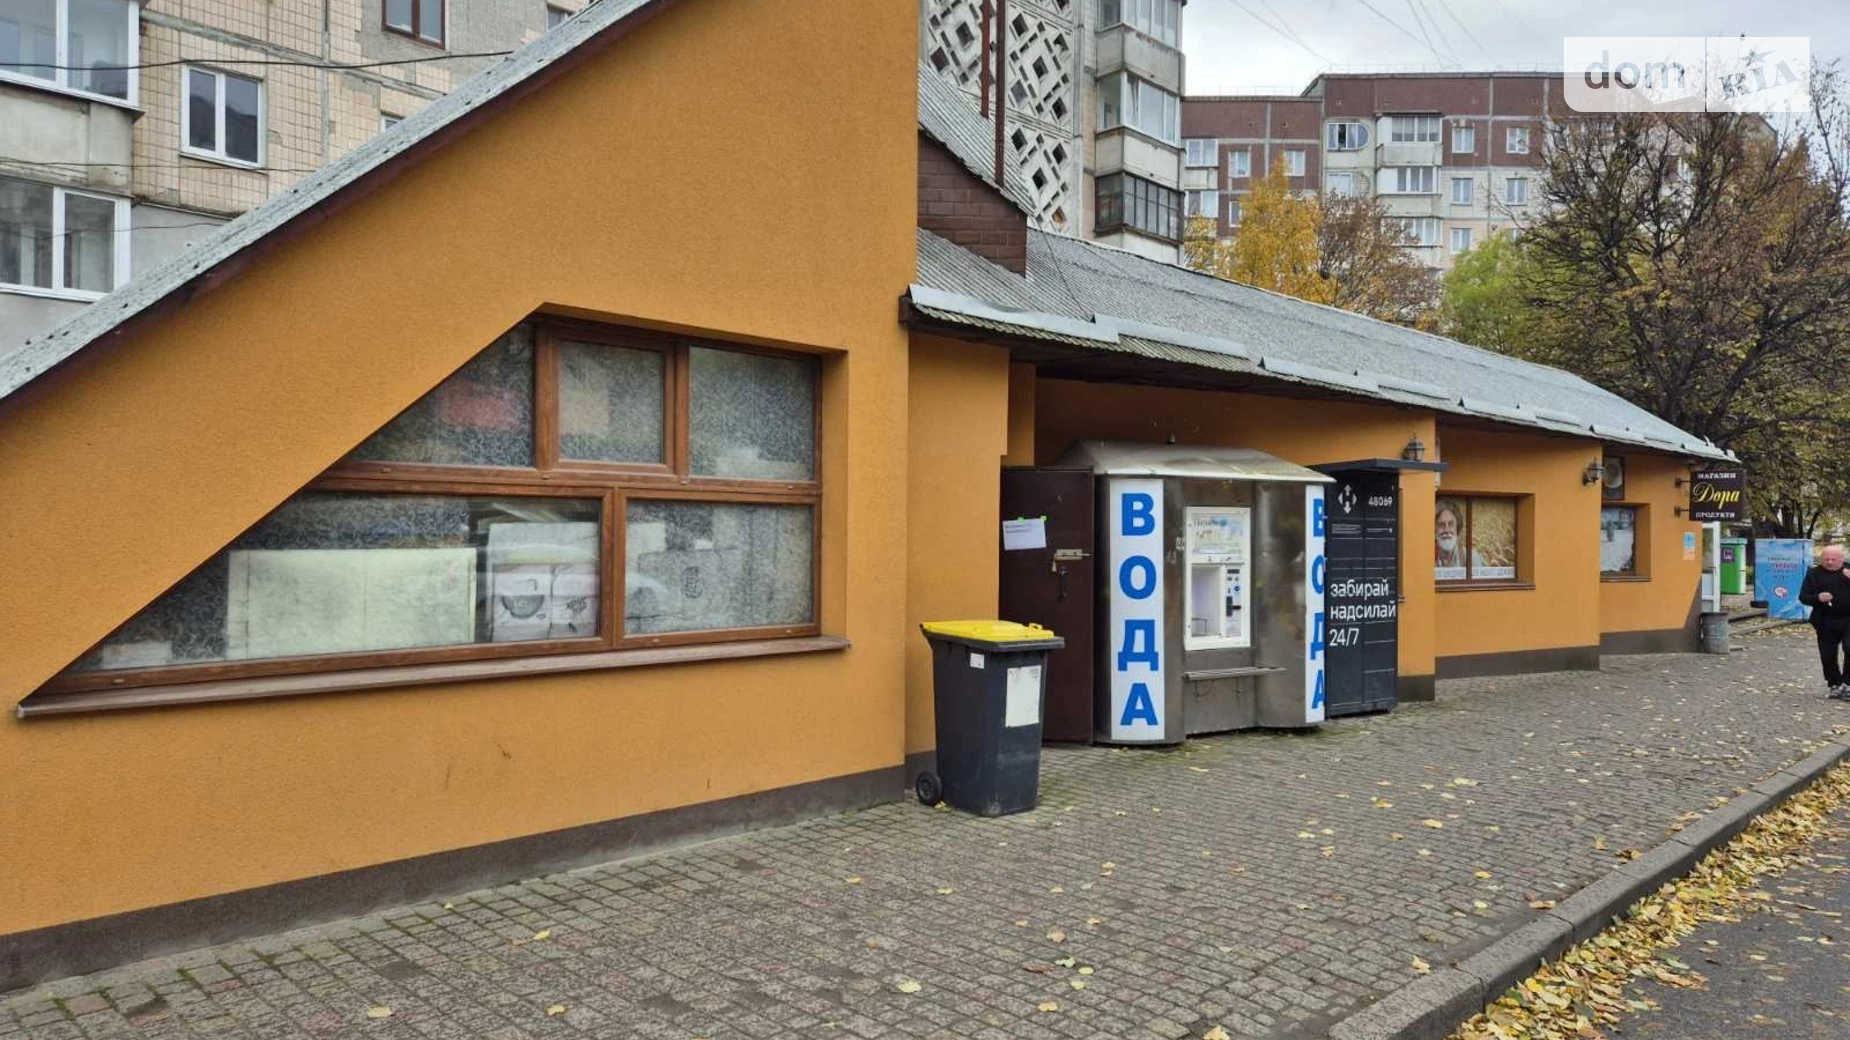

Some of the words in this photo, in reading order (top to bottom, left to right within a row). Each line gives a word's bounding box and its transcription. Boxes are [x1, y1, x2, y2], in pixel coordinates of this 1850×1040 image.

[1368, 496, 1393, 507] 48069
[1692, 481, 1740, 510] Дора
[1330, 579, 1389, 600] забирай
[1118, 493, 1160, 726] ВОДА
[1330, 600, 1396, 621] надсилай
[1329, 628, 1360, 647] 24/7
